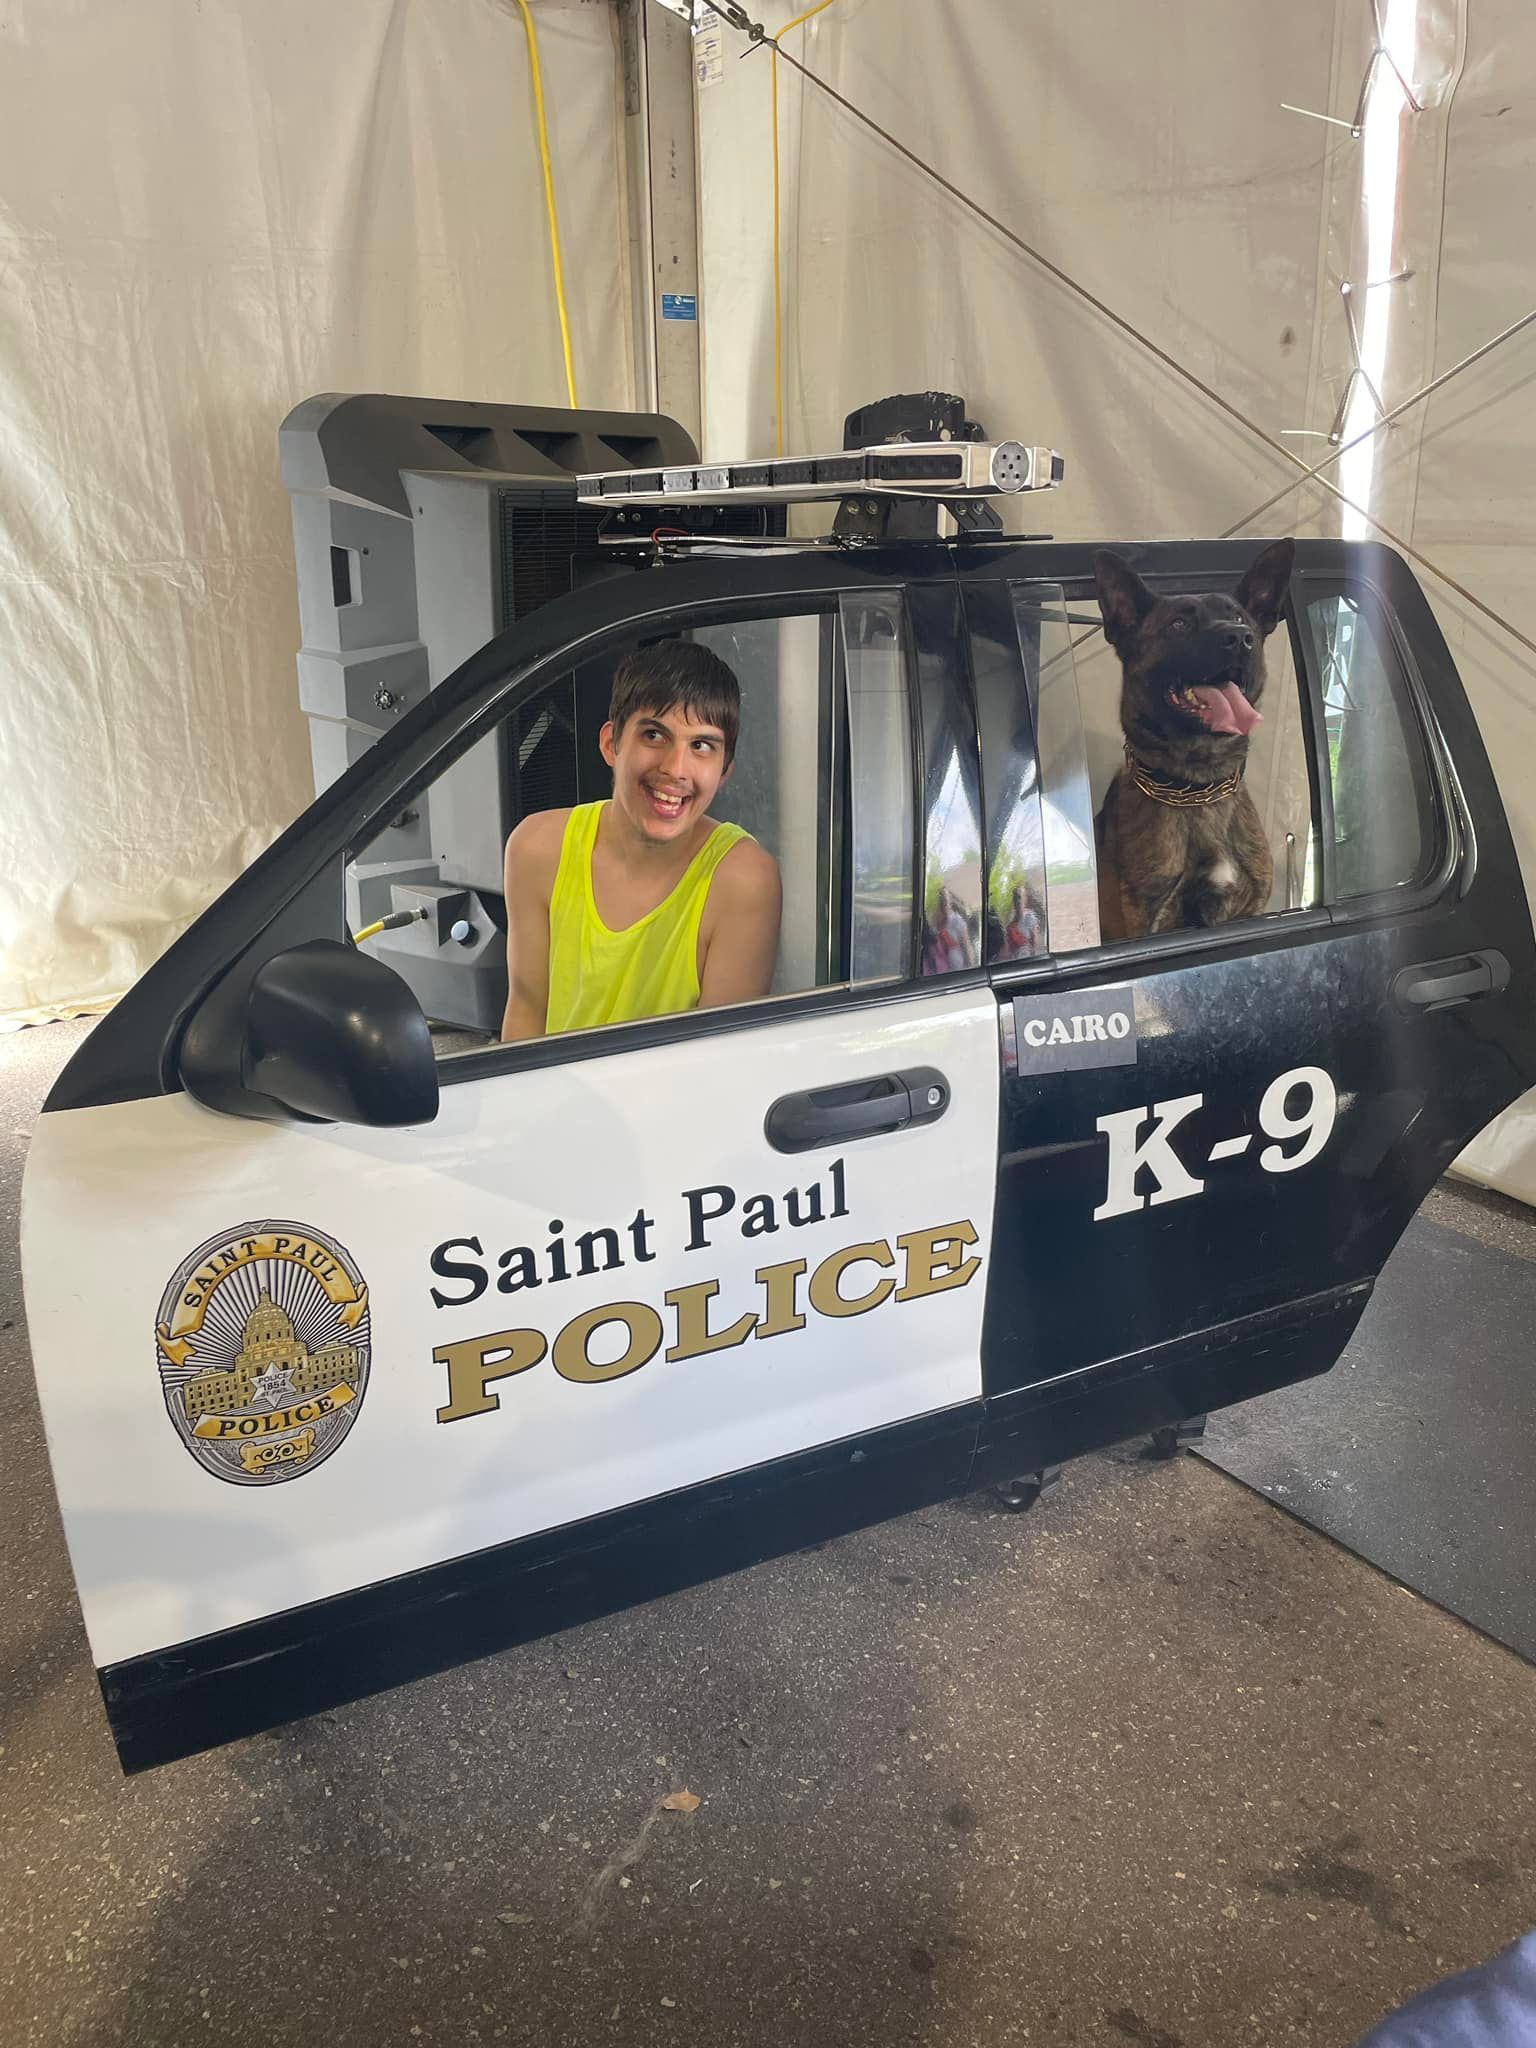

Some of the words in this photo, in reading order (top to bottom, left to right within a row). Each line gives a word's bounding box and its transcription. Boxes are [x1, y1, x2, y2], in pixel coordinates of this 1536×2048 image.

[1023, 1012, 1130, 1047] CAIRO
[1093, 1066, 1337, 1222] K-9
[429, 1208, 657, 1310] Saint
[681, 1158, 850, 1252] Paul
[184, 1239, 257, 1308] SAINT
[274, 1238, 338, 1283] PAUL
[432, 1219, 982, 1425] POLICE
[258, 1373, 288, 1383] POLICE
[263, 1379, 287, 1391] 1854
[216, 1395, 335, 1437] POLICE
